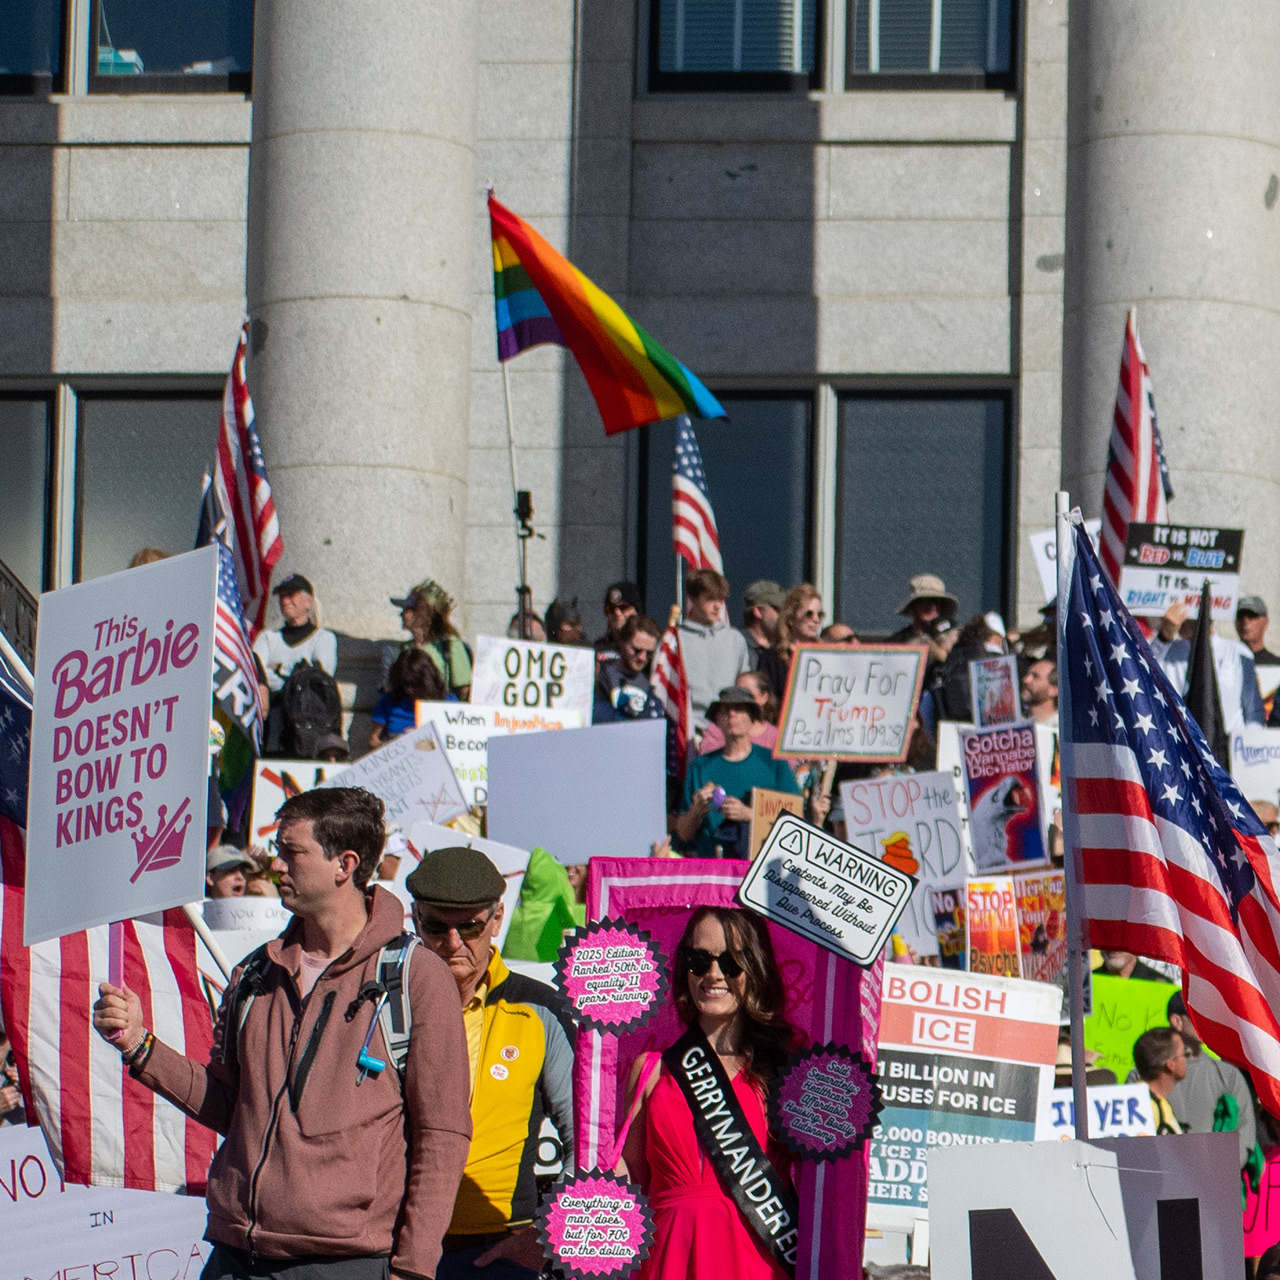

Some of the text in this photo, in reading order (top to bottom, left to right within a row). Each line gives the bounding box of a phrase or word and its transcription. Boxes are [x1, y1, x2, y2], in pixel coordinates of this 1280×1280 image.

[1155, 526, 1218, 547] IT IS NOT
[1139, 544, 1225, 568] RED BLUE
[1158, 574, 1171, 588] IT
[1127, 591, 1167, 605] RIGHT
[94, 614, 139, 651] This
[52, 619, 199, 719] Barbie
[504, 647, 567, 680] OMG
[503, 681, 564, 708] GOP
[804, 658, 909, 705] Pray For
[445, 712, 562, 732] When Injustice
[814, 698, 885, 731] Trump
[53, 695, 179, 763] DOESN'T
[792, 720, 854, 747] Psalms
[963, 728, 1034, 754] Gotcha
[361, 742, 407, 775] KINGS
[966, 747, 1036, 772] Wannabe
[56, 743, 168, 805] BOW TO
[851, 778, 953, 826] STOP the
[56, 791, 144, 848] KINGS
[814, 843, 898, 897] WARNING
[782, 859, 874, 914] Contents May Be
[763, 869, 830, 912] Disappeared
[831, 904, 878, 935] Without
[933, 891, 954, 913] No
[968, 891, 1013, 911] STOP
[776, 896, 844, 939] Due Process
[575, 948, 645, 961] 2025 Edition:
[572, 961, 651, 976] Ranked 50th in
[586, 975, 640, 992] equality 11
[882, 976, 1007, 1015] BOLISH
[578, 990, 651, 1009] years running
[917, 1017, 972, 1045] ICE
[1099, 1002, 1133, 1033] No
[808, 1067, 861, 1095] Separately:
[827, 1061, 850, 1077] Sold
[890, 1060, 995, 1088] BILLION IN
[801, 1094, 848, 1118] Affordable
[802, 1081, 852, 1108] Healthcare,
[938, 1090, 1017, 1114] FOR ICE
[784, 1100, 855, 1138] Housing, Bodily
[790, 1118, 836, 1144] Autonomy
[681, 1046, 798, 1266] GERRYMANDERED
[880, 1143, 911, 1160] ICE
[560, 1196, 633, 1214] Everything a
[90, 1210, 114, 1228] IN
[567, 1215, 592, 1225] man
[564, 1229, 584, 1241] but
[584, 1228, 605, 1244] for
[560, 1245, 635, 1257] on the dollar
